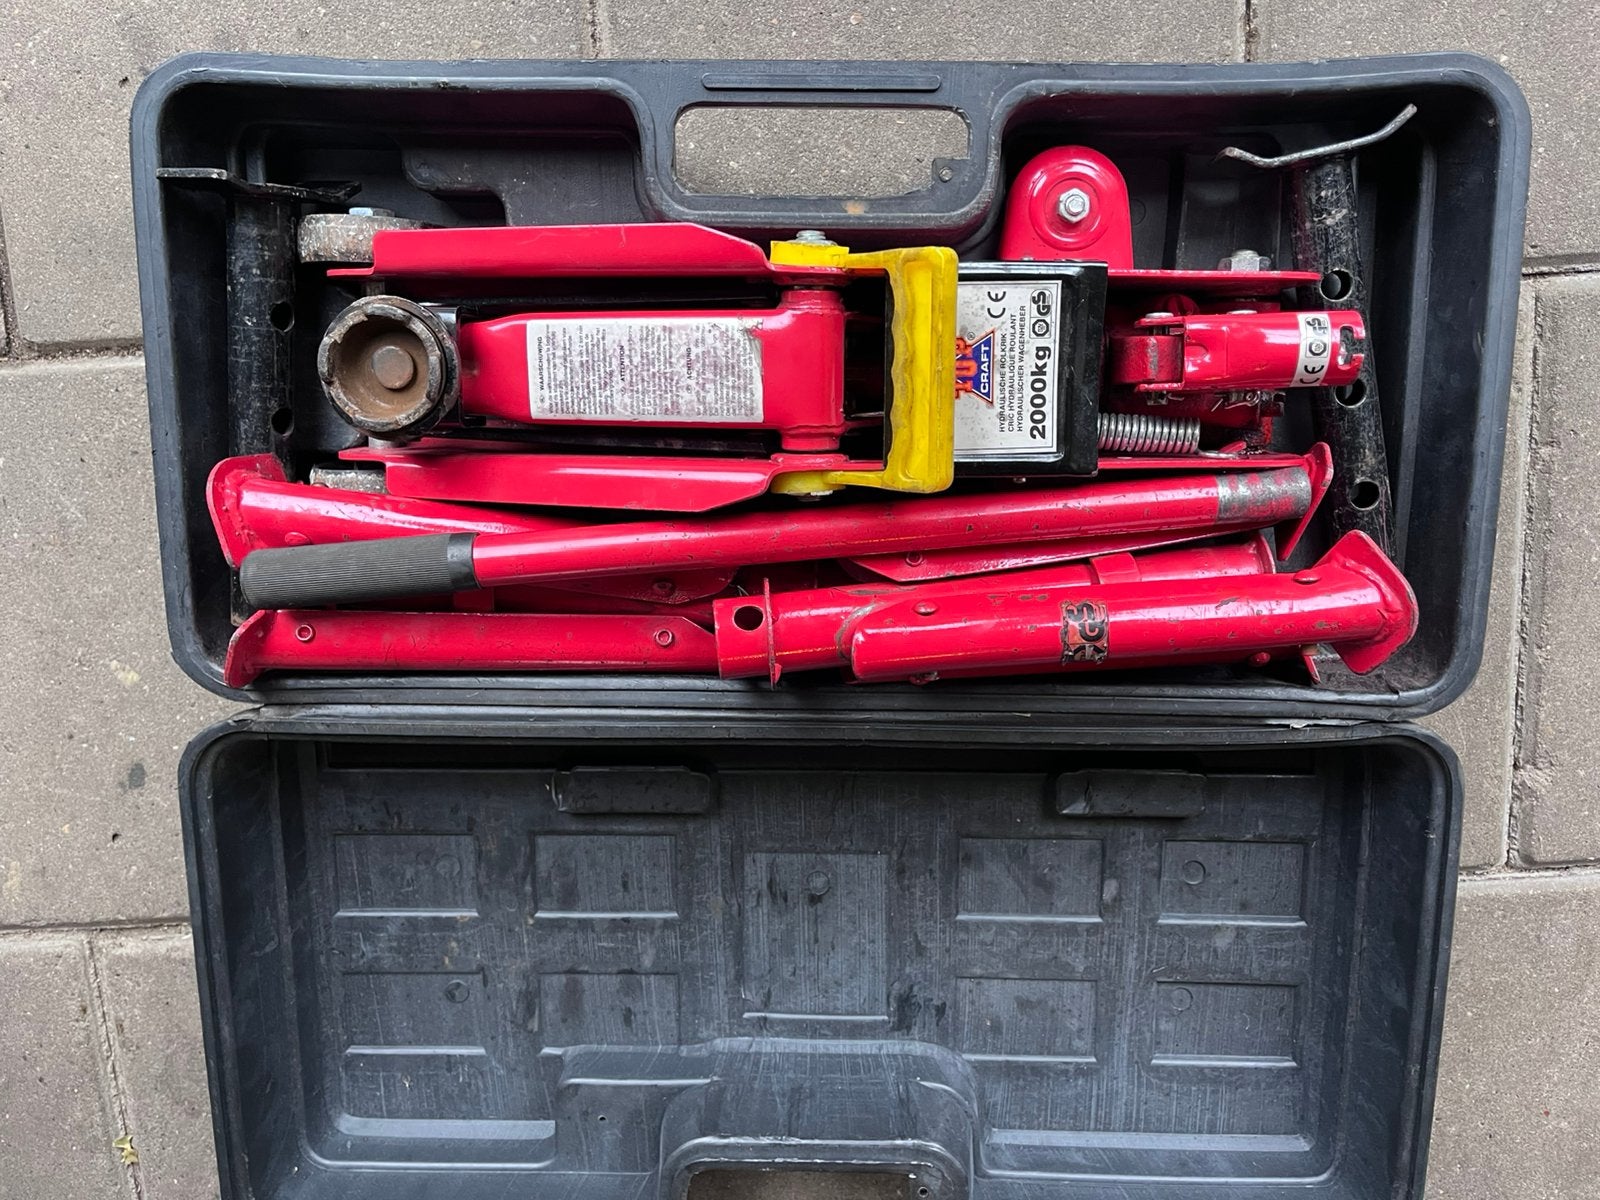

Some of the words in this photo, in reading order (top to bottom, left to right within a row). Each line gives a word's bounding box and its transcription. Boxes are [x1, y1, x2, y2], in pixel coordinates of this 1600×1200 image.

[987, 291, 1006, 319] CE
[1009, 313, 1017, 352] ROULANT
[1018, 305, 1026, 363] WAGENHEBER
[980, 344, 989, 393] CRAFT
[1008, 354, 1016, 412] HYDRAULIQUE
[1030, 346, 1051, 440] 2000kg
[999, 371, 1007, 432] HYDRAULISCHE
[1017, 365, 1025, 432] HYDRAULISCHER
